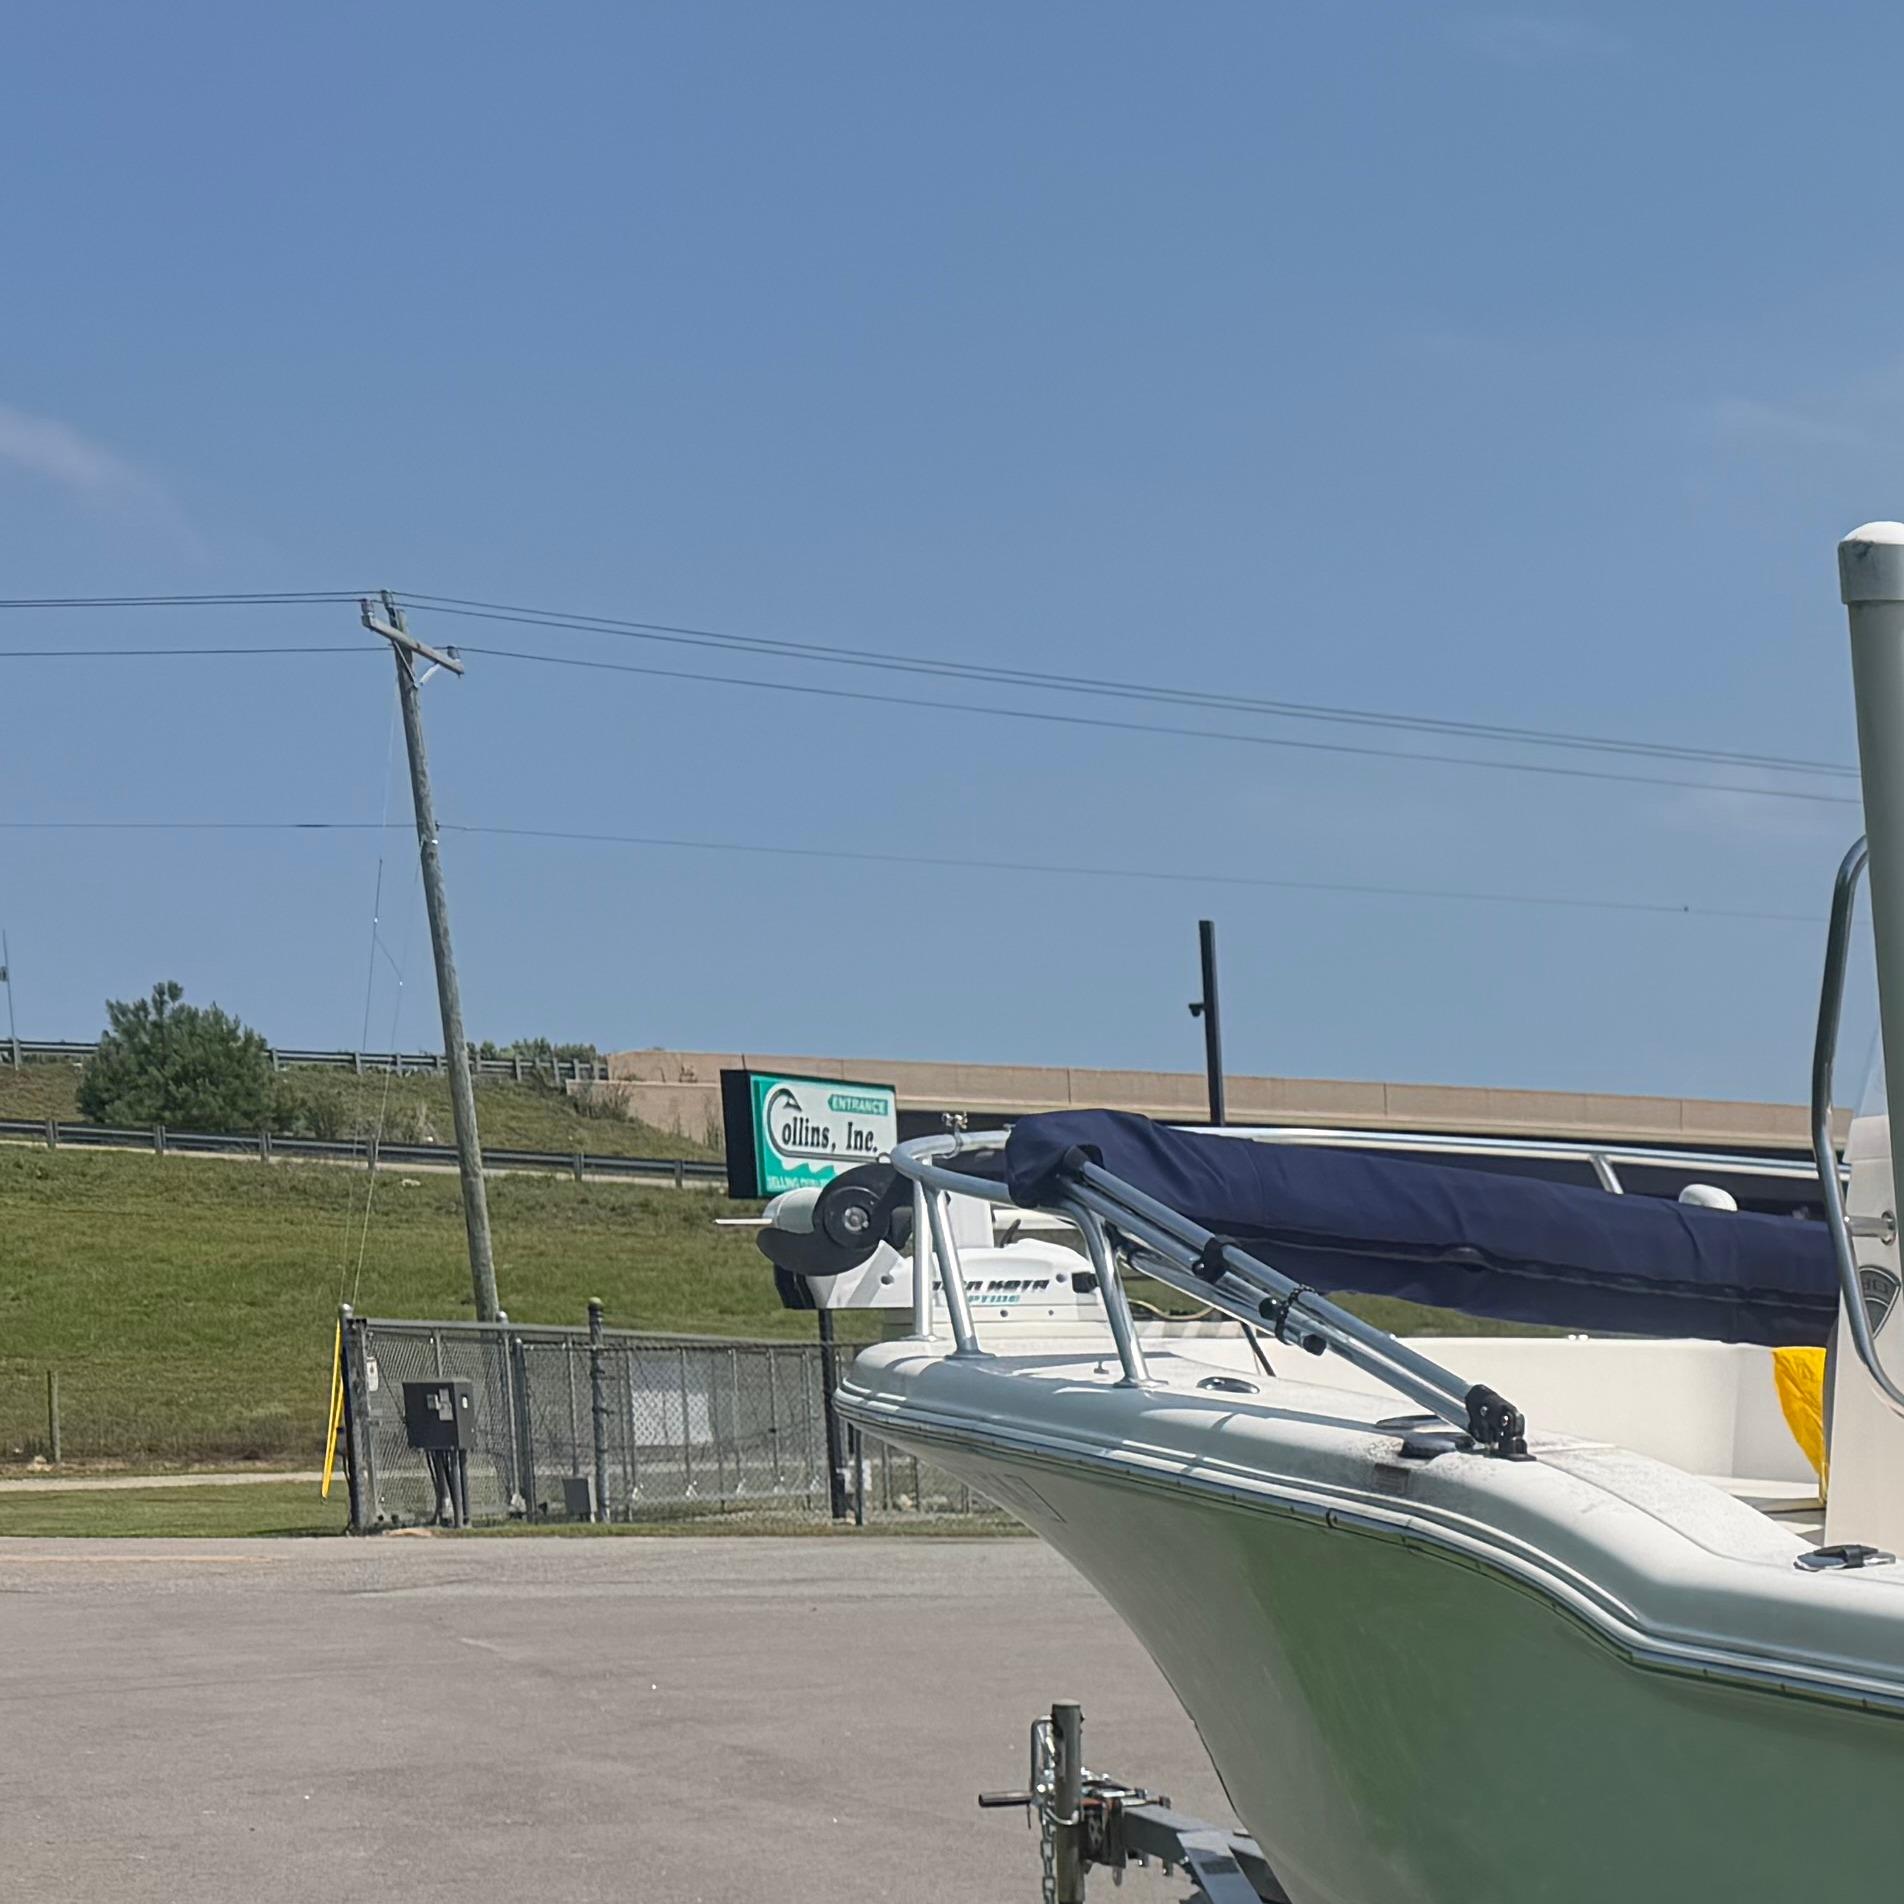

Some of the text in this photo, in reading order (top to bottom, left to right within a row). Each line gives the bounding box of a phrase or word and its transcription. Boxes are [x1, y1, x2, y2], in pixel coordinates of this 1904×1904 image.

[832, 1095, 886, 1115] ENTRANCE
[846, 1121, 878, 1153] Inc.
[986, 1279, 1050, 1293] KOTA
